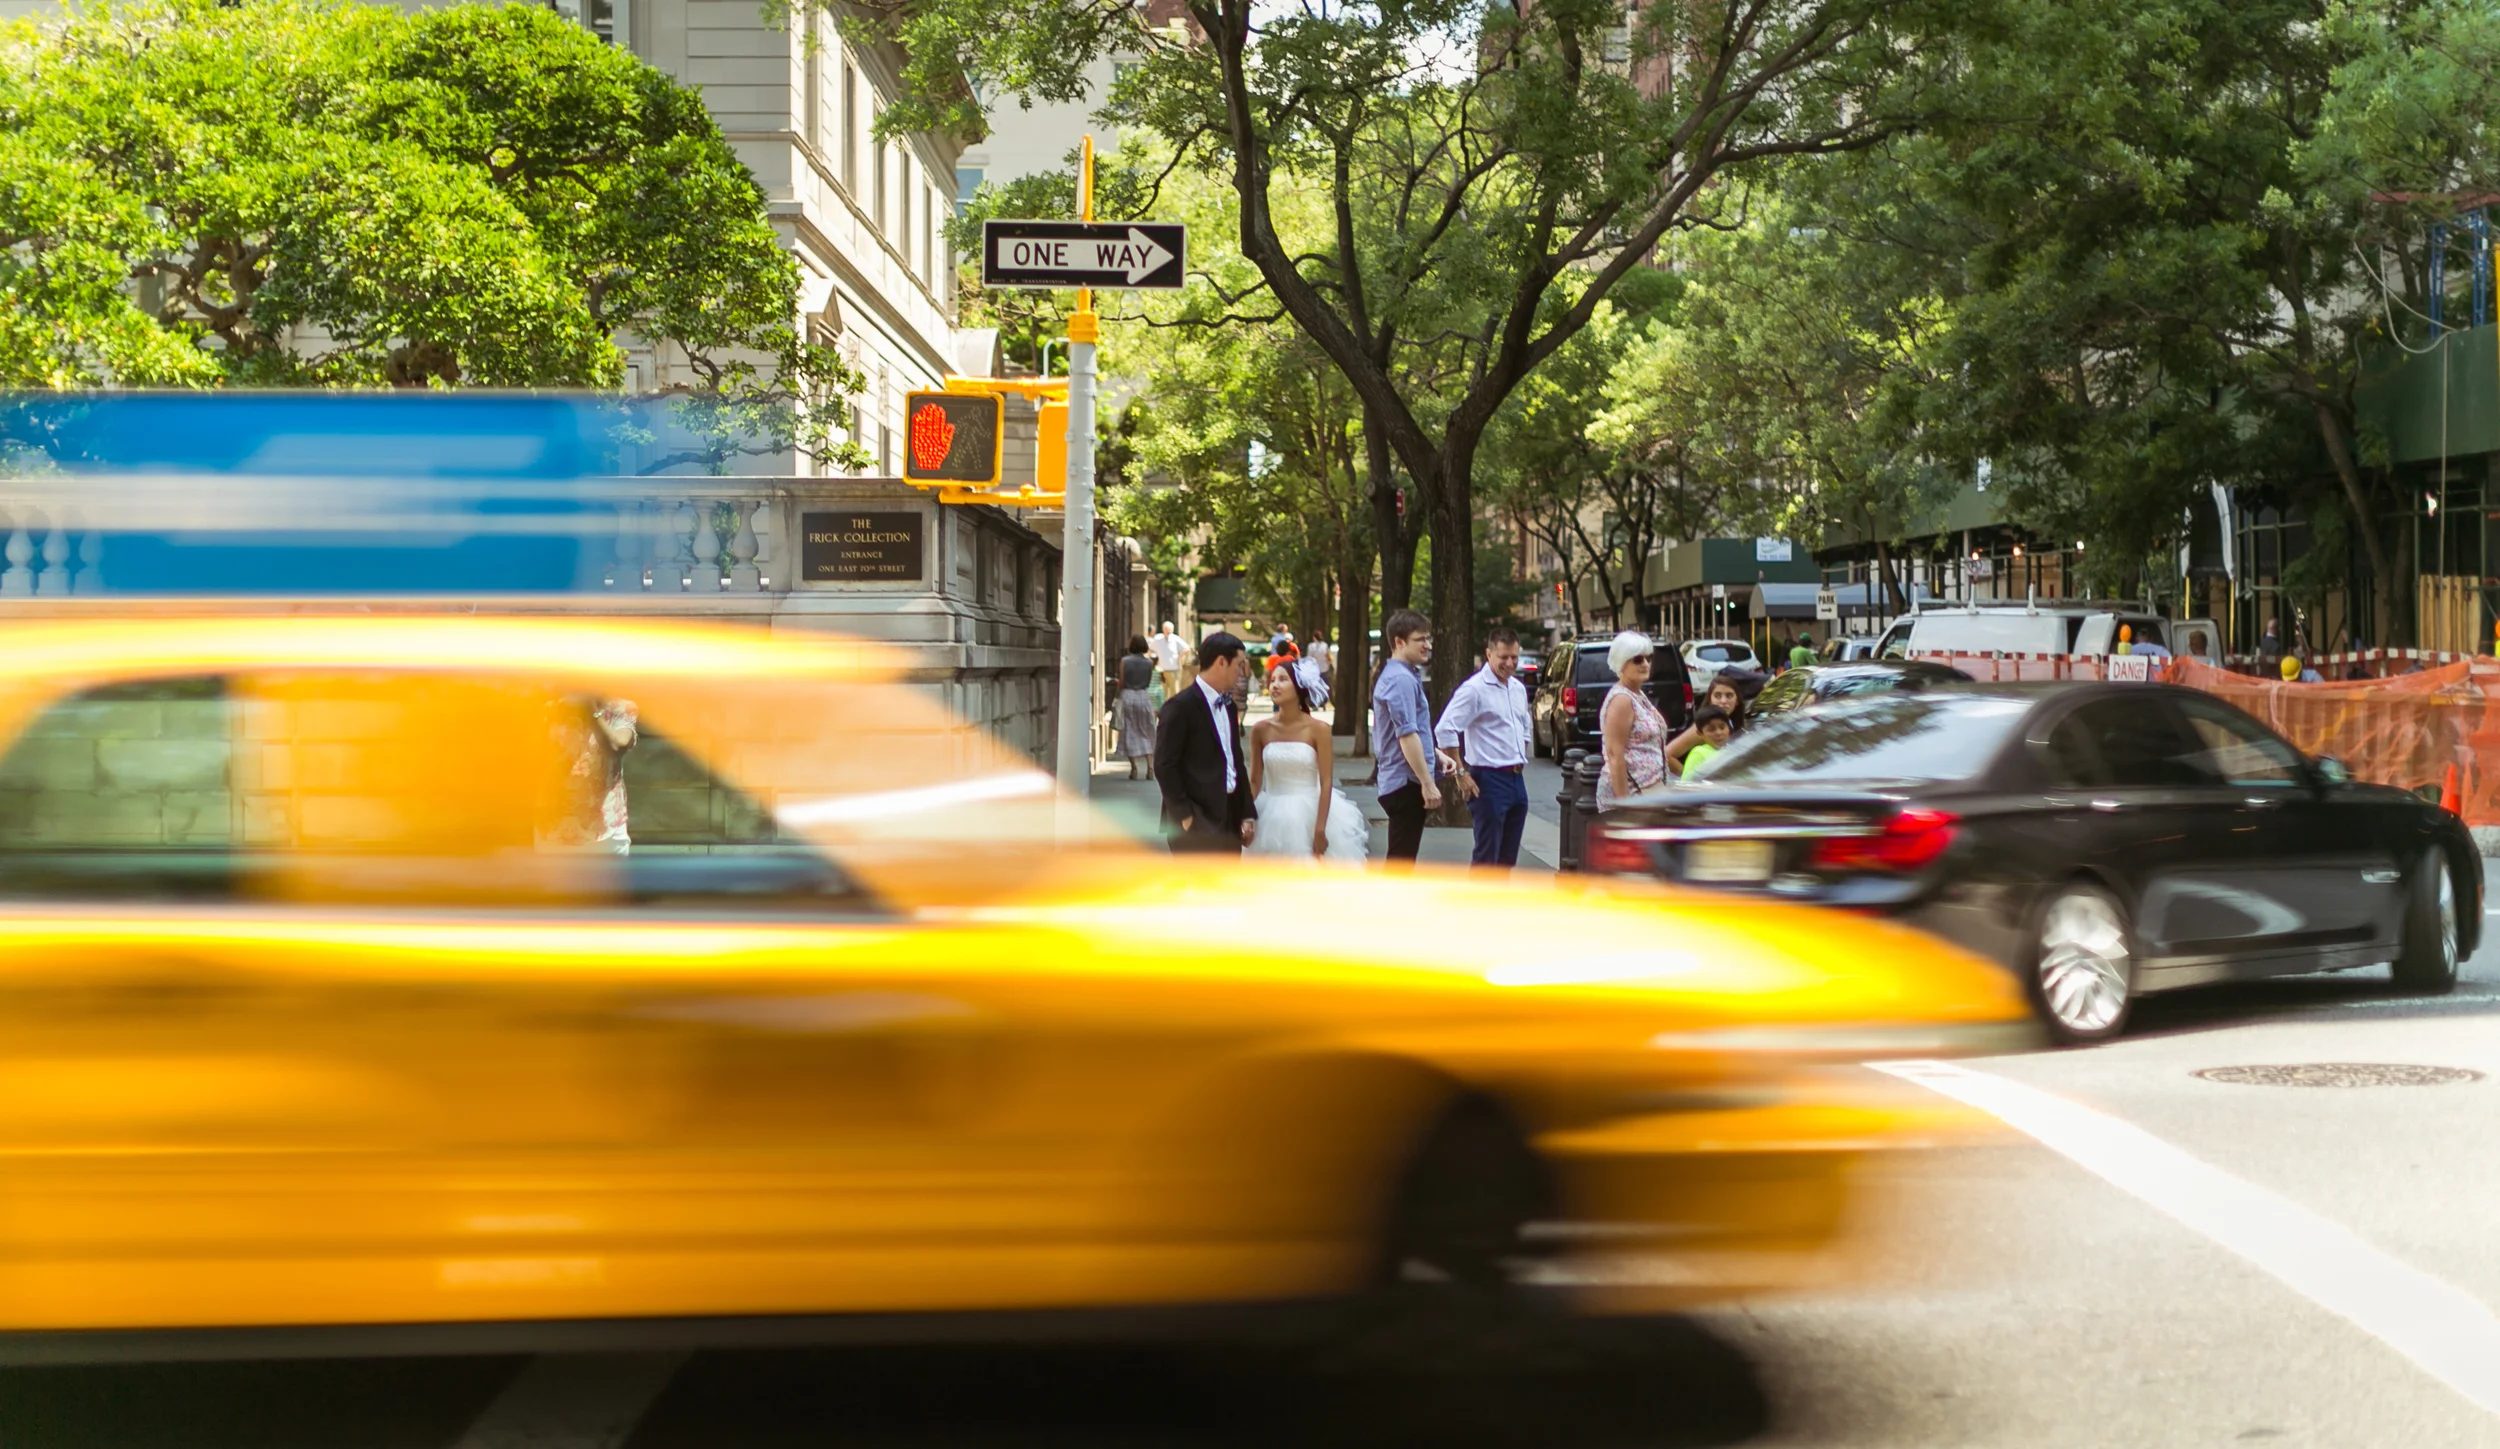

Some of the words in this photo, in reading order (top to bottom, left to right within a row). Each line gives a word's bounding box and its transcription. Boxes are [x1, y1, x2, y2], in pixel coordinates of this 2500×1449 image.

[1014, 242, 1069, 267] ONE
[1096, 244, 1154, 269] WAY
[852, 518, 872, 529] THE
[809, 532, 840, 543] FRICK
[844, 532, 911, 543] COLLECTION
[841, 551, 883, 559] ENTRANCE
[818, 565, 835, 573] ONE
[839, 565, 857, 573] EAST
[879, 565, 906, 573] STREET
[1818, 595, 1835, 604] PARK
